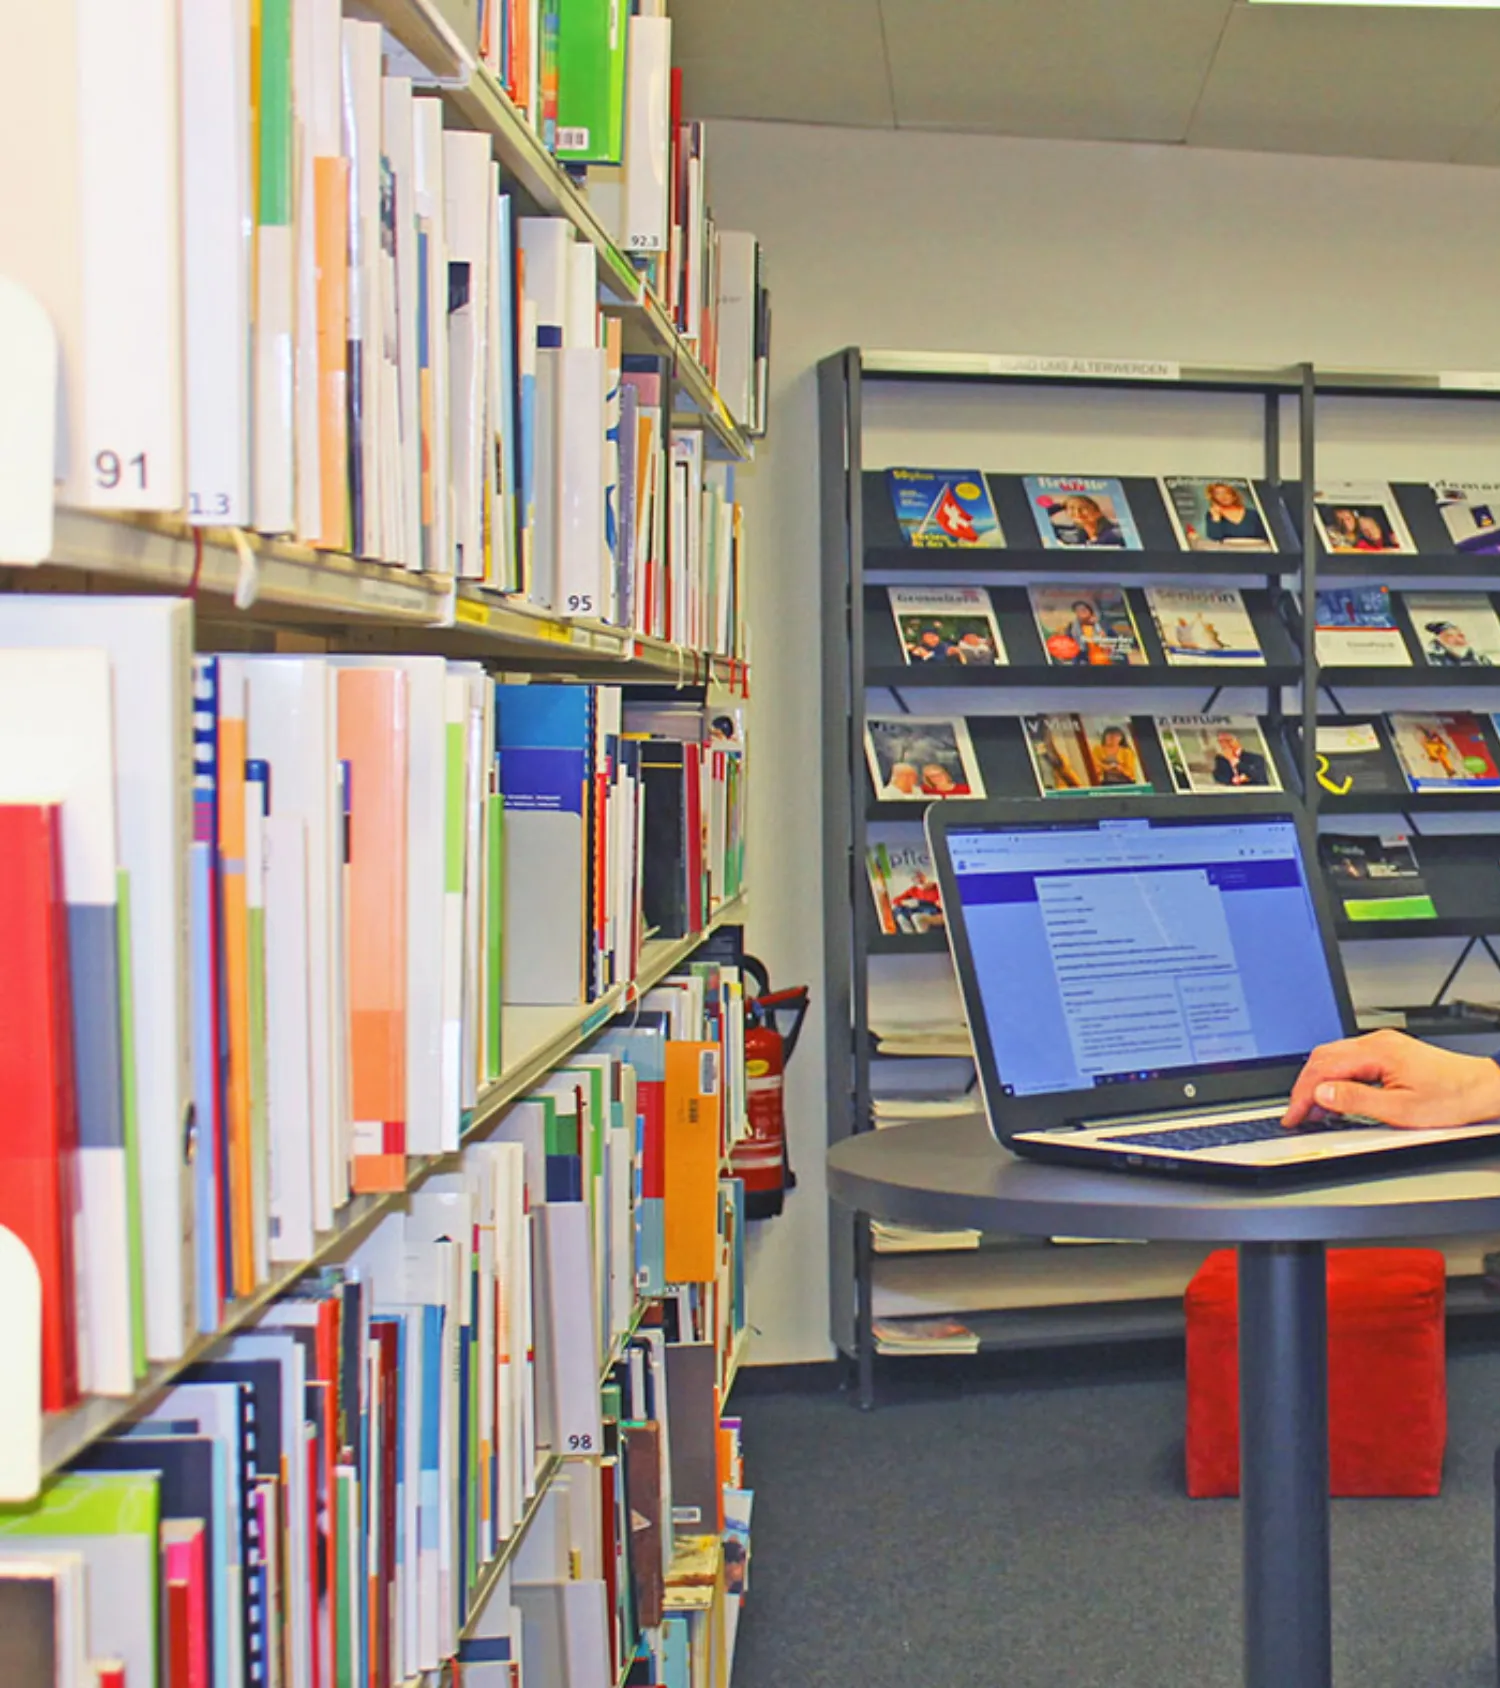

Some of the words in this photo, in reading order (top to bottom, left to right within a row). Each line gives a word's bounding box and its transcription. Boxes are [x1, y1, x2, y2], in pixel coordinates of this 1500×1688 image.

[631, 235, 658, 247] 92.3
[95, 450, 149, 489] 91
[569, 595, 592, 612] 95
[892, 848, 929, 869] pfle
[568, 1434, 592, 1450] 98
